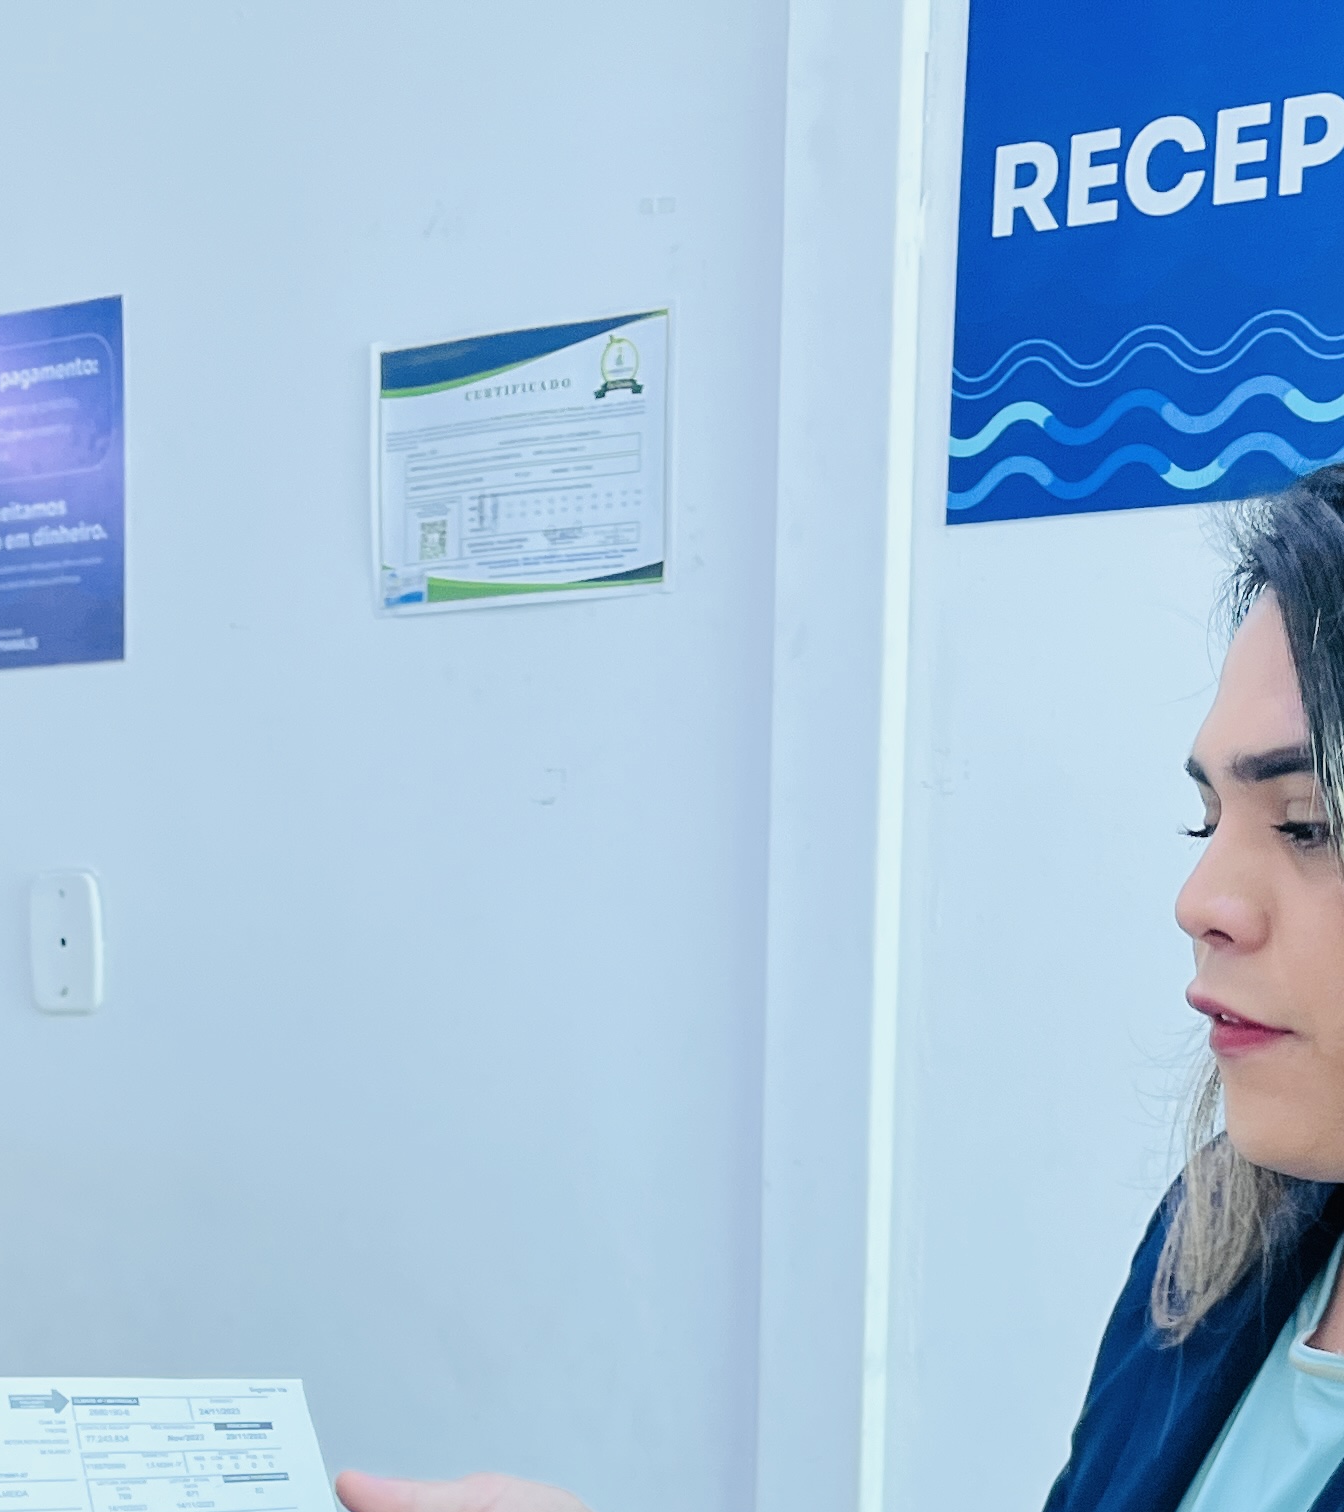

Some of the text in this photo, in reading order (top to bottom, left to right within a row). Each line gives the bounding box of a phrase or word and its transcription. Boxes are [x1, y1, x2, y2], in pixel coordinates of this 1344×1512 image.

[0, 357, 99, 393] pagamento:
[465, 378, 571, 401] CERTIFICADO
[4, 532, 31, 551] em
[32, 520, 108, 547] dinheiro.
